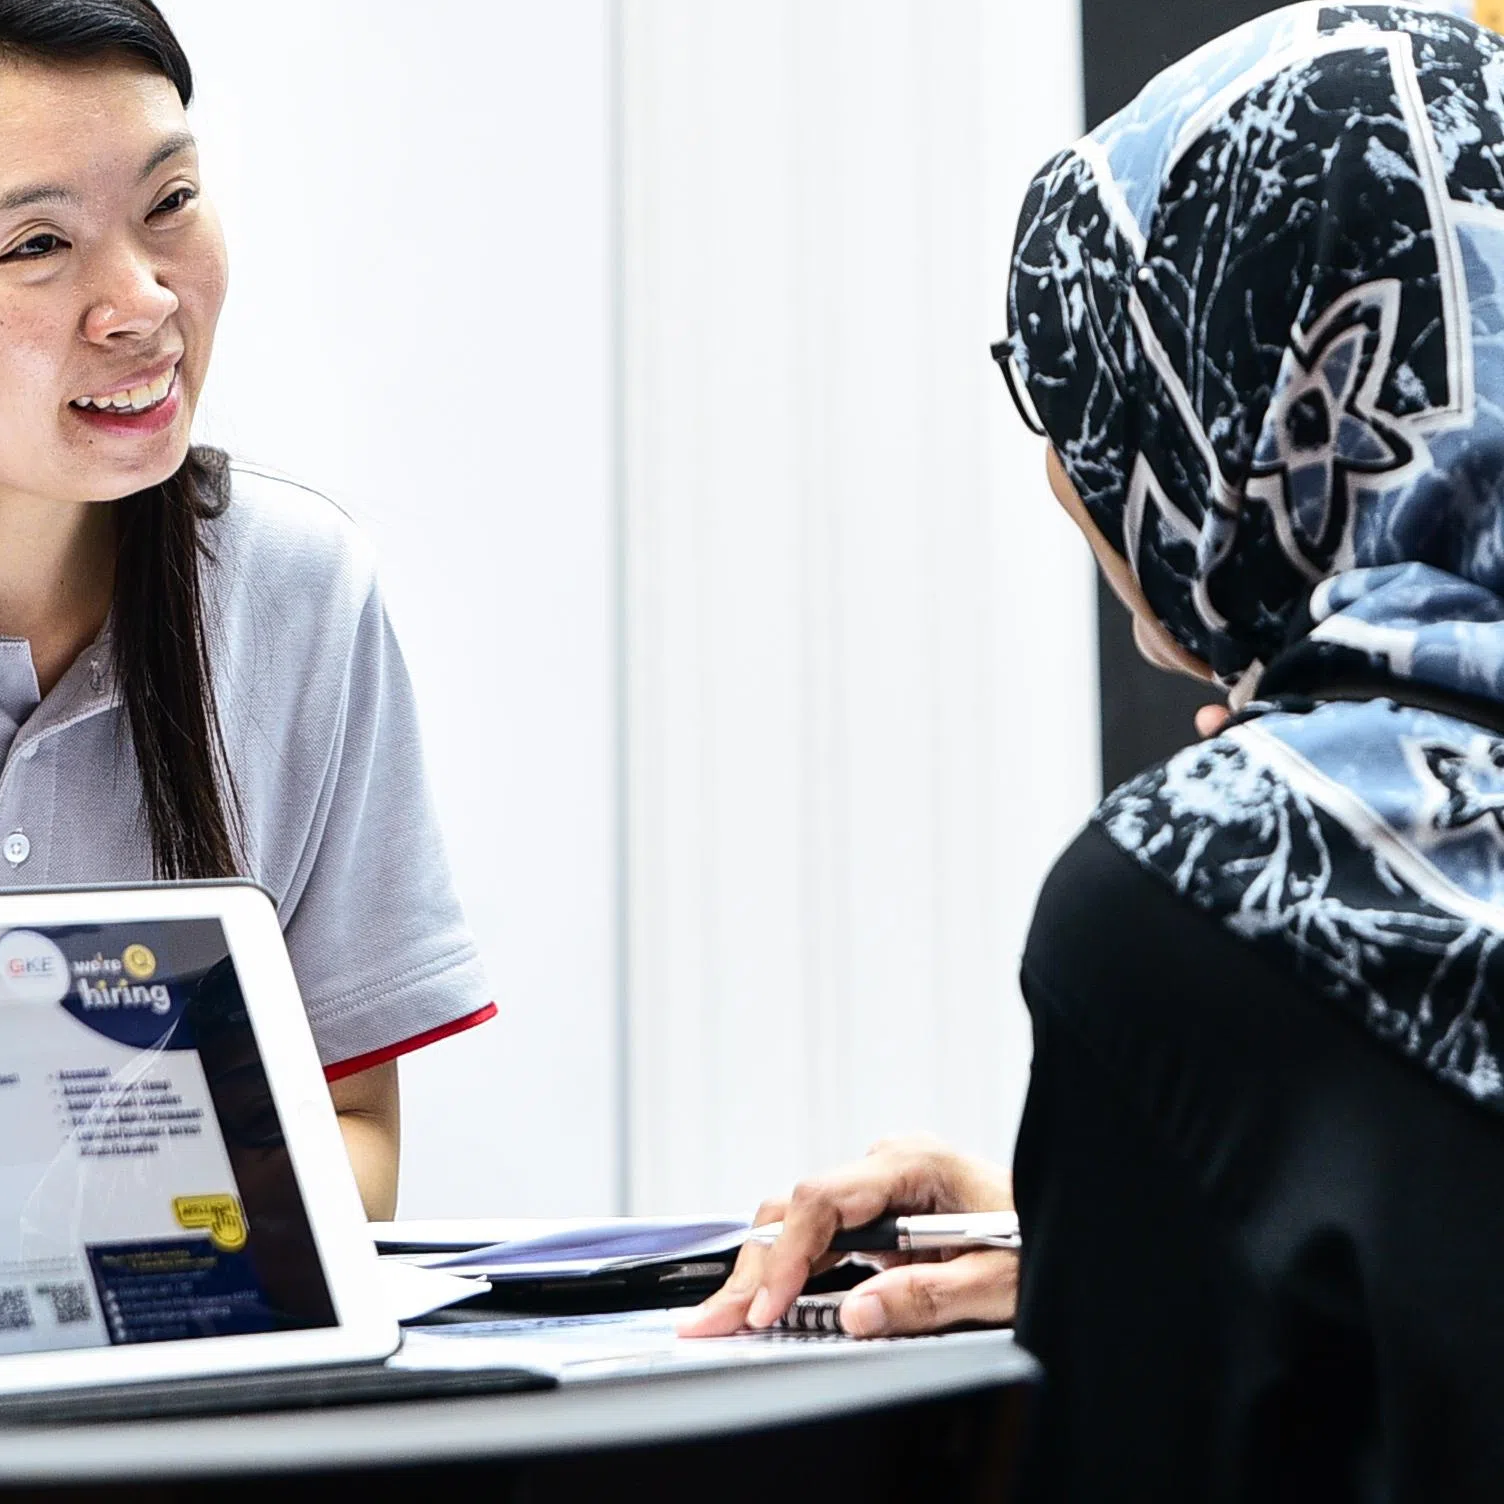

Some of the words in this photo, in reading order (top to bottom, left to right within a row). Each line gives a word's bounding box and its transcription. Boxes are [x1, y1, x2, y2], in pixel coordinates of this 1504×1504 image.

[8, 956, 55, 975] GKE
[72, 952, 122, 975] we're
[75, 978, 172, 1015] hiring
